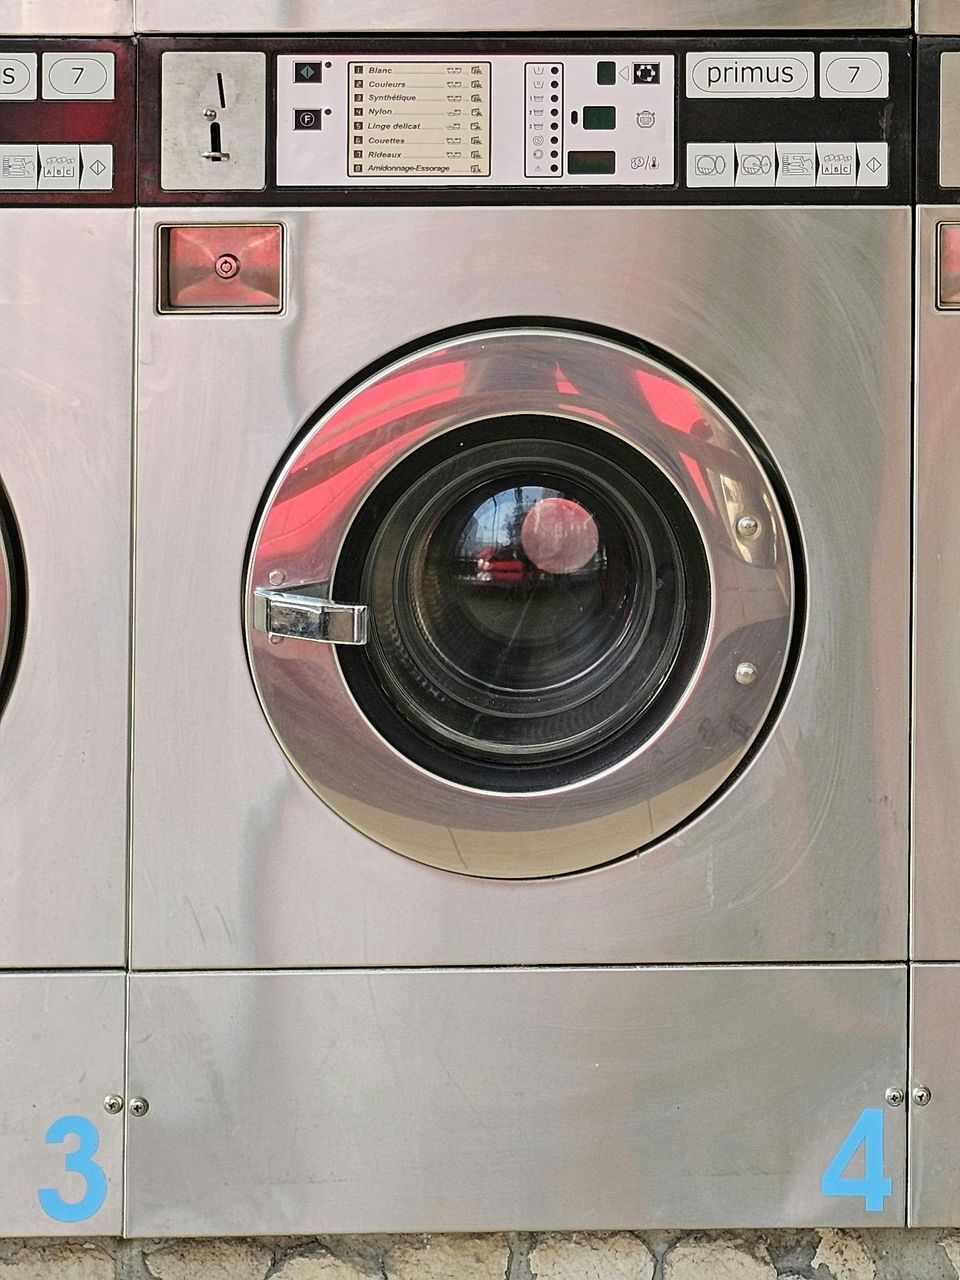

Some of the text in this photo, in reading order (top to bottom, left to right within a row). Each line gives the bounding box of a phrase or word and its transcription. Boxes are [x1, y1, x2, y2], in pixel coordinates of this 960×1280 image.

[72, 67, 84, 85] 7
[708, 61, 794, 88] primus
[848, 66, 860, 83] 7
[368, 94, 417, 102] Synthétique
[368, 108, 393, 116] Nylon
[37, 1114, 108, 1223] 3
[821, 1107, 893, 1212] 4
